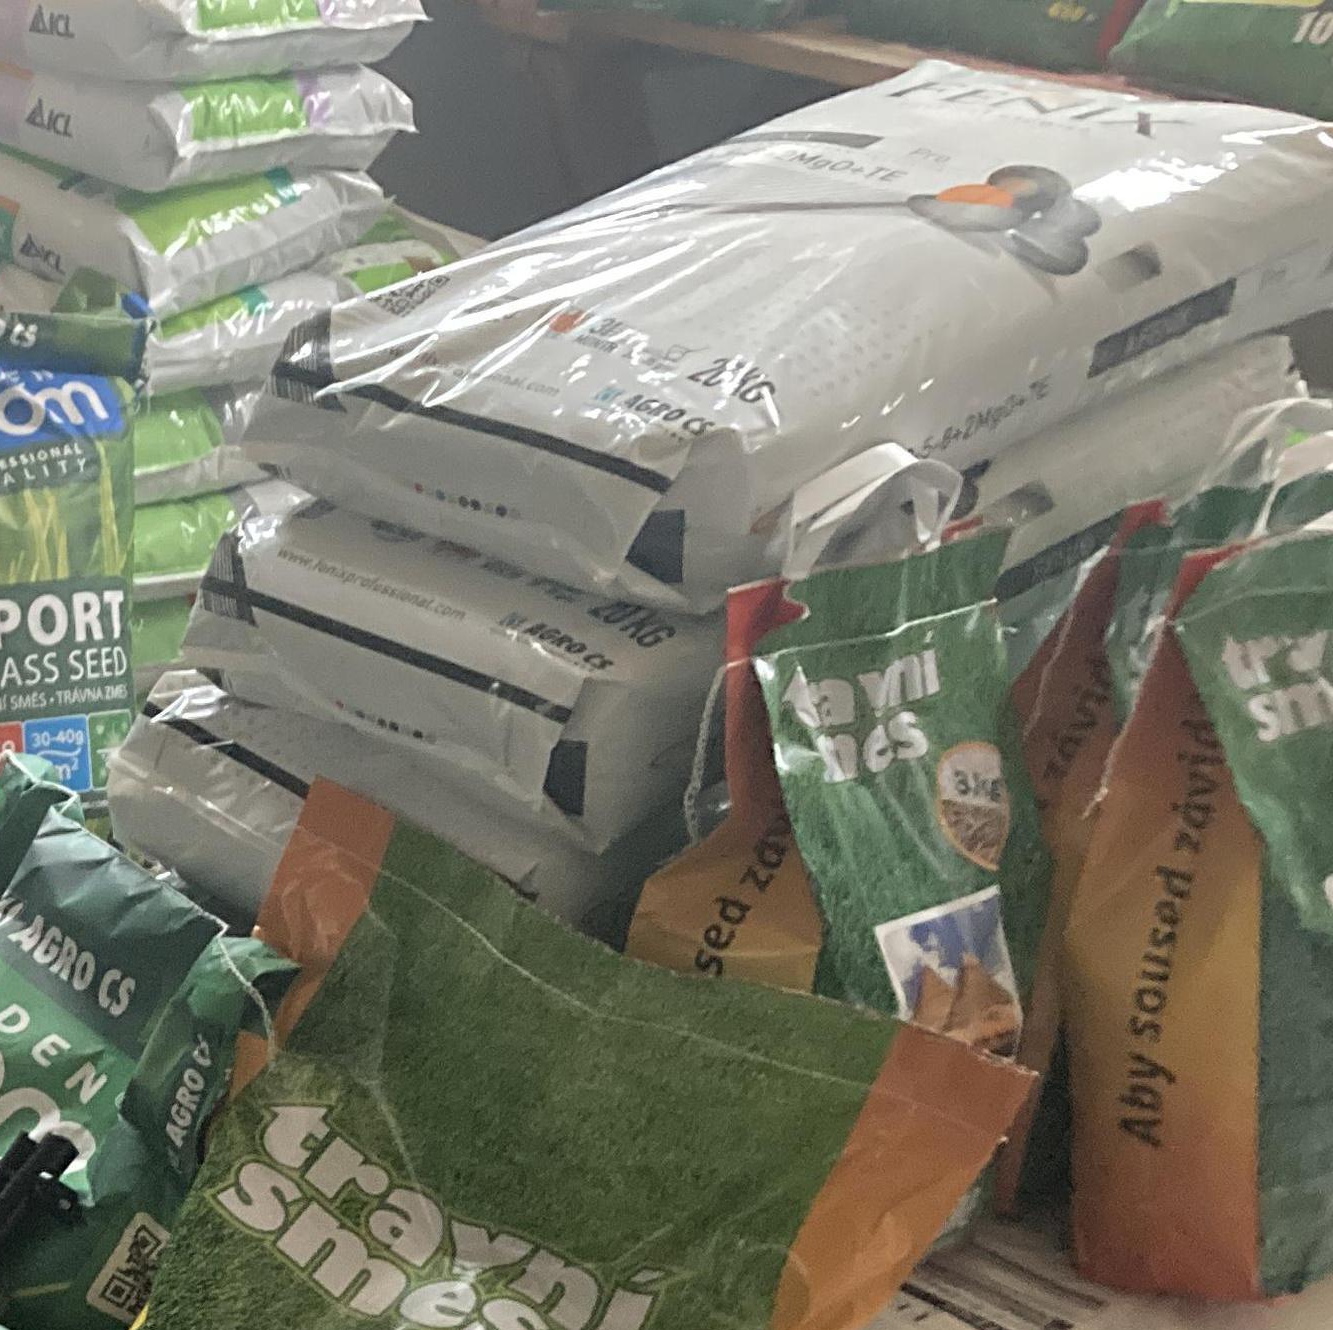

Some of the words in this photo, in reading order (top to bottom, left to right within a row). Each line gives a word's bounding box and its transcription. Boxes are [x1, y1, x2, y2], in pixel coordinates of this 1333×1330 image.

[9, 321, 39, 348] CS
[68, 645, 128, 681] SEED
[32, 728, 85, 750] 30-40g
[6, 914, 98, 992] AGRO
[97, 968, 136, 1019] CS
[1130, 864, 1194, 1044] soused
[164, 1067, 206, 1149] AGRO
[1116, 1057, 1179, 1149] Aby
